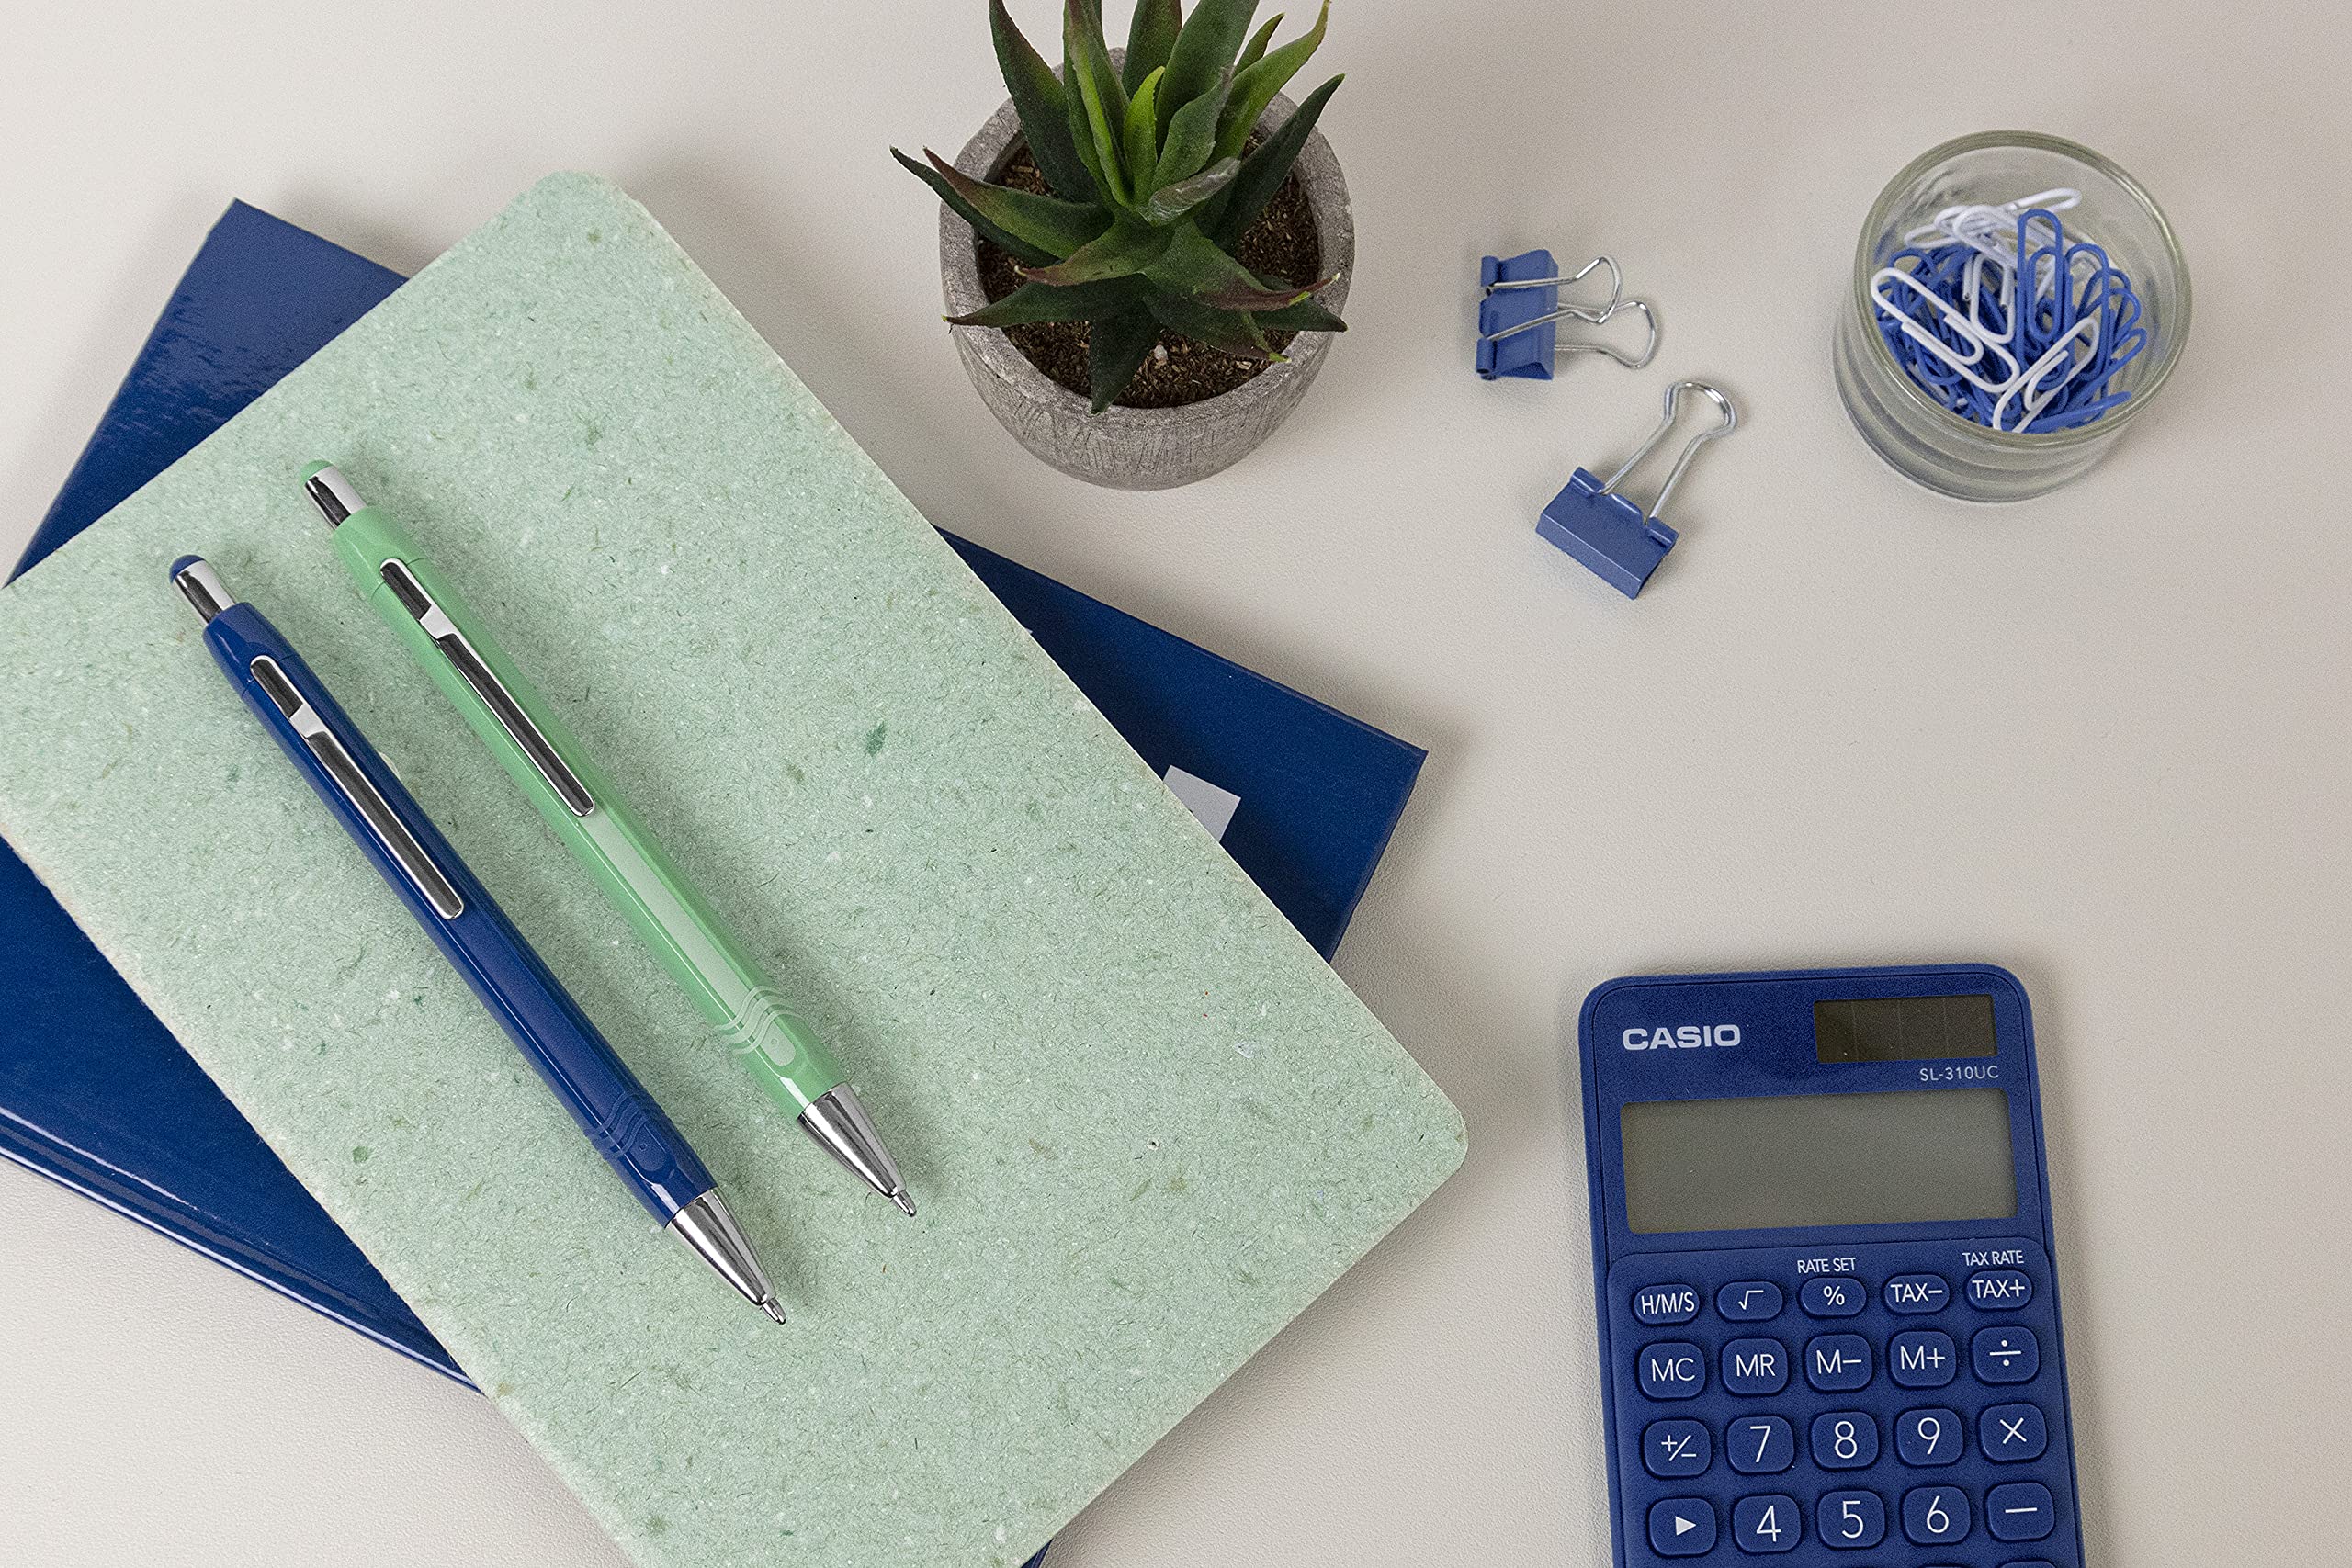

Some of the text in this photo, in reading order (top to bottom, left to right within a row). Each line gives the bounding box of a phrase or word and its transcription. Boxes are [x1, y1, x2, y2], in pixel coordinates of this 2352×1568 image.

[1623, 1024, 1740, 1051] CASIO
[1919, 1065, 1999, 1082] SL-310UC
[1797, 1257, 1856, 1274] RATE SET
[1962, 1249, 2025, 1267] TAX RATE
[1823, 1285, 1845, 1306] %
[1890, 1282, 1943, 1303] TAX-
[1972, 1279, 2026, 1299] TAX+
[1641, 1292, 1695, 1315] H/M/S
[1651, 1357, 1695, 1382] MC
[1736, 1353, 1776, 1377] MR
[1816, 1348, 1862, 1374] M-
[1900, 1345, 1946, 1370] M+
[1749, 1425, 1771, 1463] 7
[1834, 1420, 1858, 1459] 8
[1917, 1416, 1940, 1455] 9
[1756, 1505, 1781, 1542] 4
[1841, 1500, 1864, 1539] 5
[1926, 1495, 1950, 1534] 6
